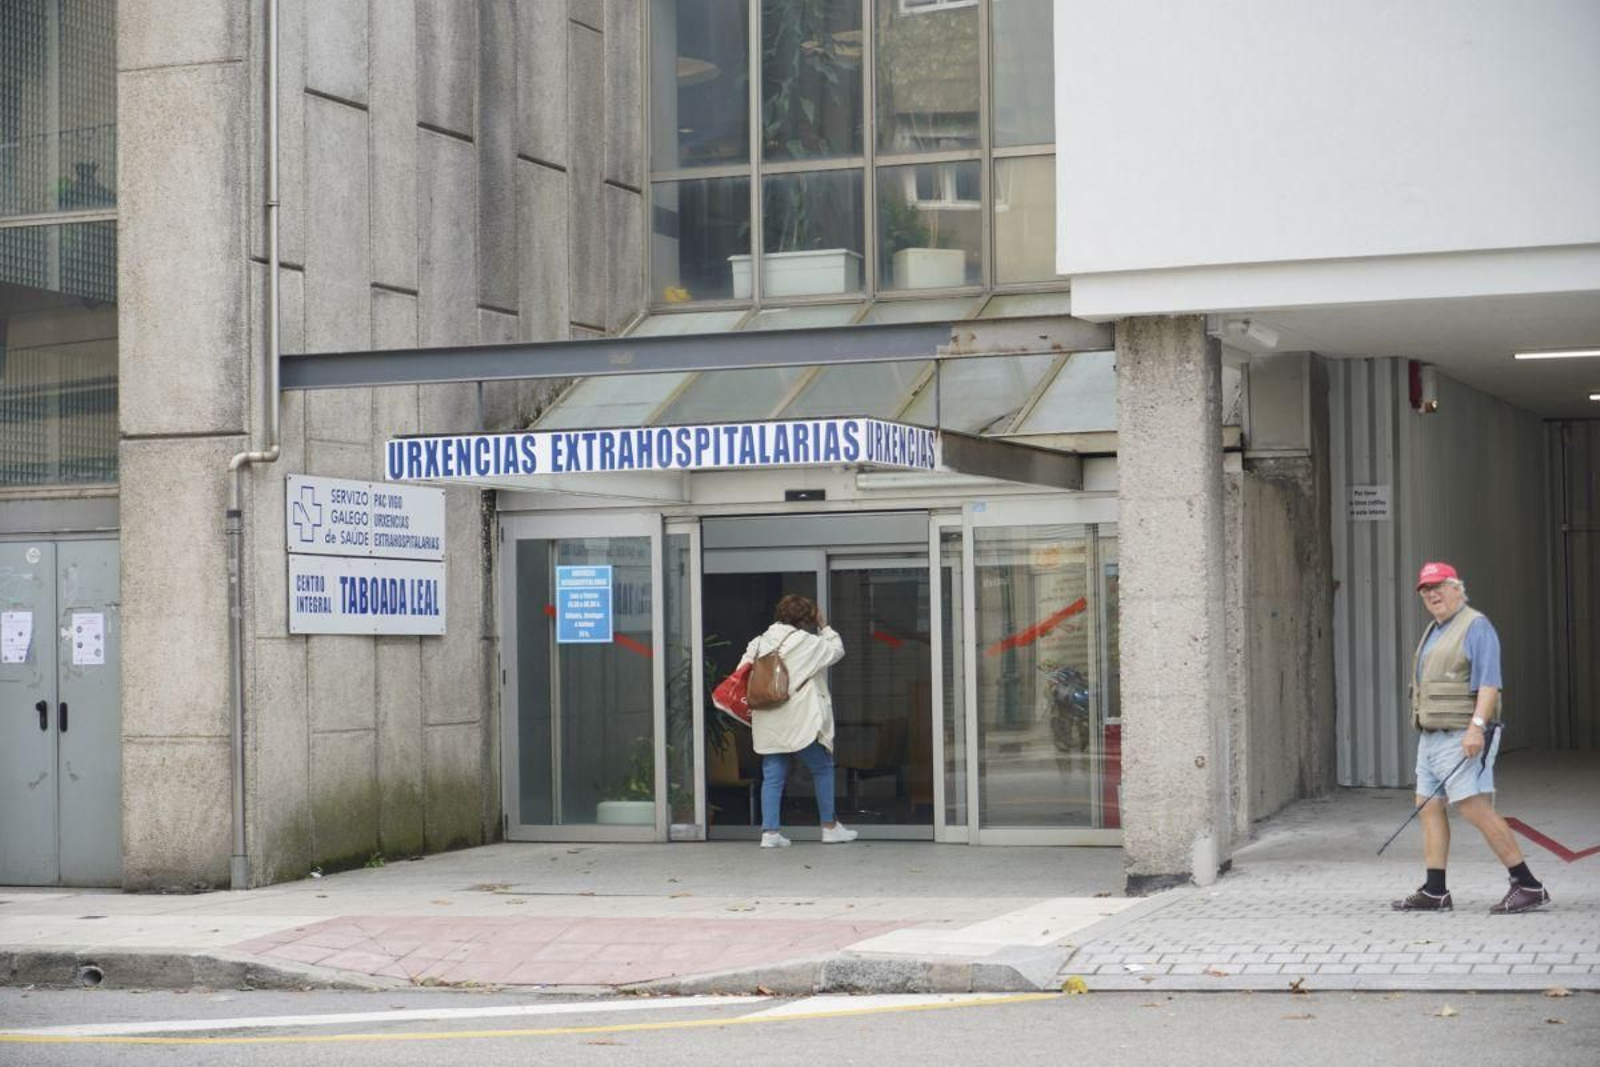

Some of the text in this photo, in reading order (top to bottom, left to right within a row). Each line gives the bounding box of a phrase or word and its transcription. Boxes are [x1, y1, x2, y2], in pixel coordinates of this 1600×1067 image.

[388, 420, 860, 480] URXENCIAS EXTRAHOSPITALARIAS
[865, 419, 936, 470] URXENCIAS
[331, 488, 369, 506] SERVIZO
[374, 494, 402, 510] PAC VIGO
[331, 509, 369, 526] GALEGO
[374, 513, 410, 530] URXENCIAS
[325, 529, 337, 544] de
[374, 532, 440, 550] EXTRAHOSPITALARIAS
[296, 574, 325, 593] CENTRO
[296, 596, 332, 614] INTEGRAL
[340, 576, 440, 616] TABOADA LEAL
